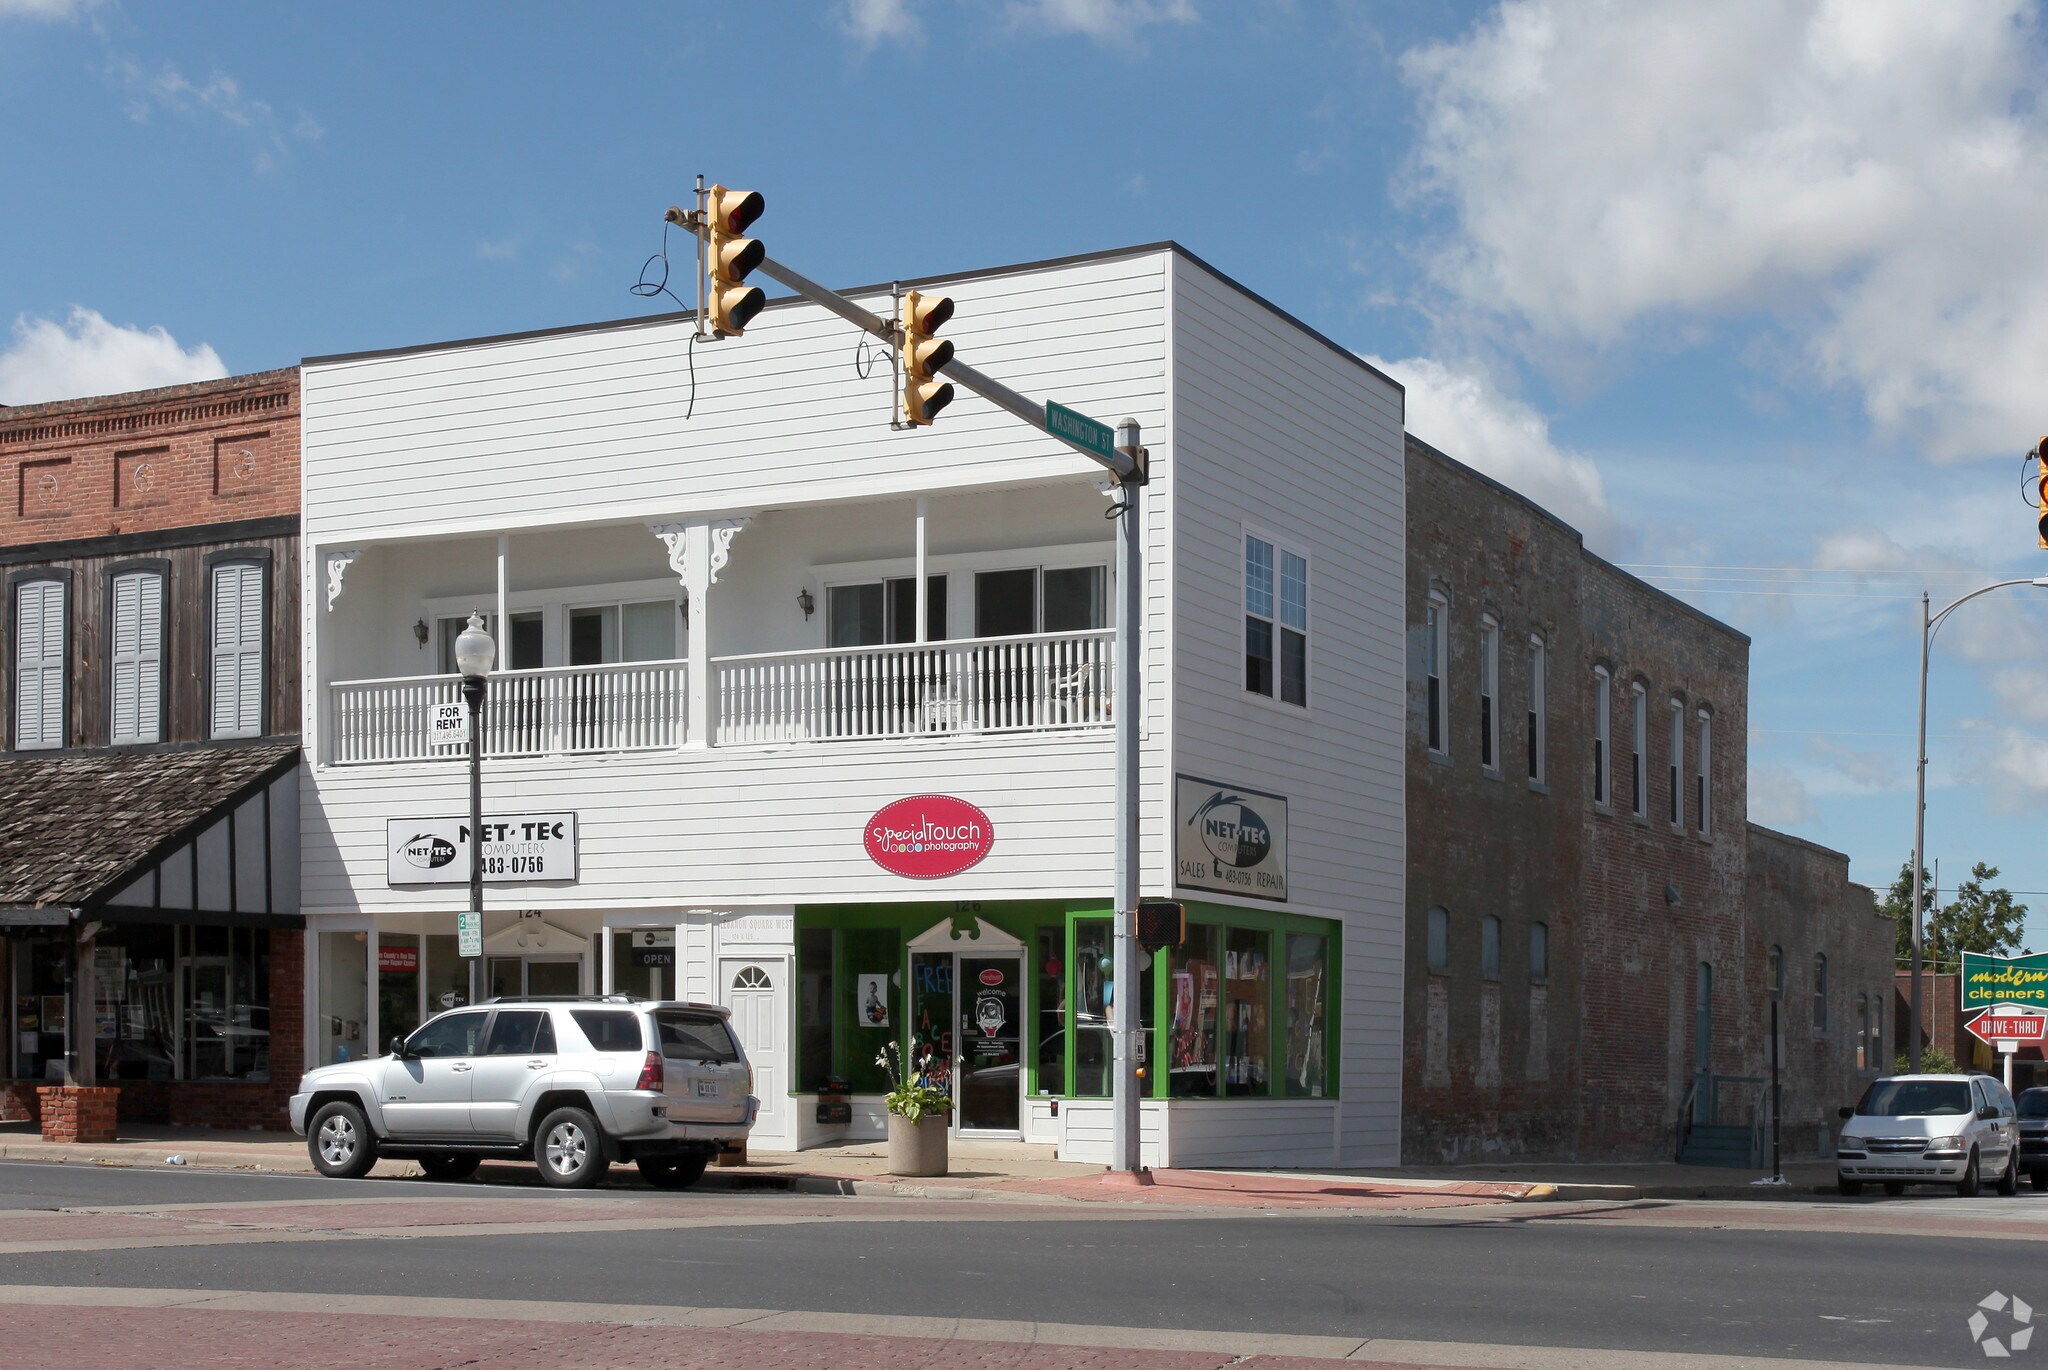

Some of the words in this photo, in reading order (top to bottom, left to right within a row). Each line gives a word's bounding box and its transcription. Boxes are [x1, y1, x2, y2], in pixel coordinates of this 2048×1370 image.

[1051, 408, 1098, 446] WASHINGTON
[1101, 431, 1110, 452] ST
[439, 706, 460, 718] FOR
[436, 718, 463, 730] RENT
[482, 843, 545, 856] OMPUTERS
[924, 841, 980, 852] photography
[1217, 841, 1257, 857] COMPUTERS
[481, 856, 544, 874] 483-0756
[1180, 860, 1205, 879] SALES
[1225, 869, 1252, 887] 483-0756
[1256, 872, 1284, 890] REPAIR
[954, 901, 982, 913] 126
[519, 910, 542, 918] 124
[460, 916, 465, 928] 2
[720, 919, 747, 929] LEBANON
[749, 919, 773, 930] SQUARE
[776, 919, 793, 929] WEST
[643, 954, 671, 964] OPEN
[915, 962, 952, 994] FREE
[1968, 965, 2048, 986] modern
[976, 988, 1007, 998] welcome
[1968, 986, 2046, 999] cleaners
[1980, 1020, 2039, 1034] DRIVE-THRU
